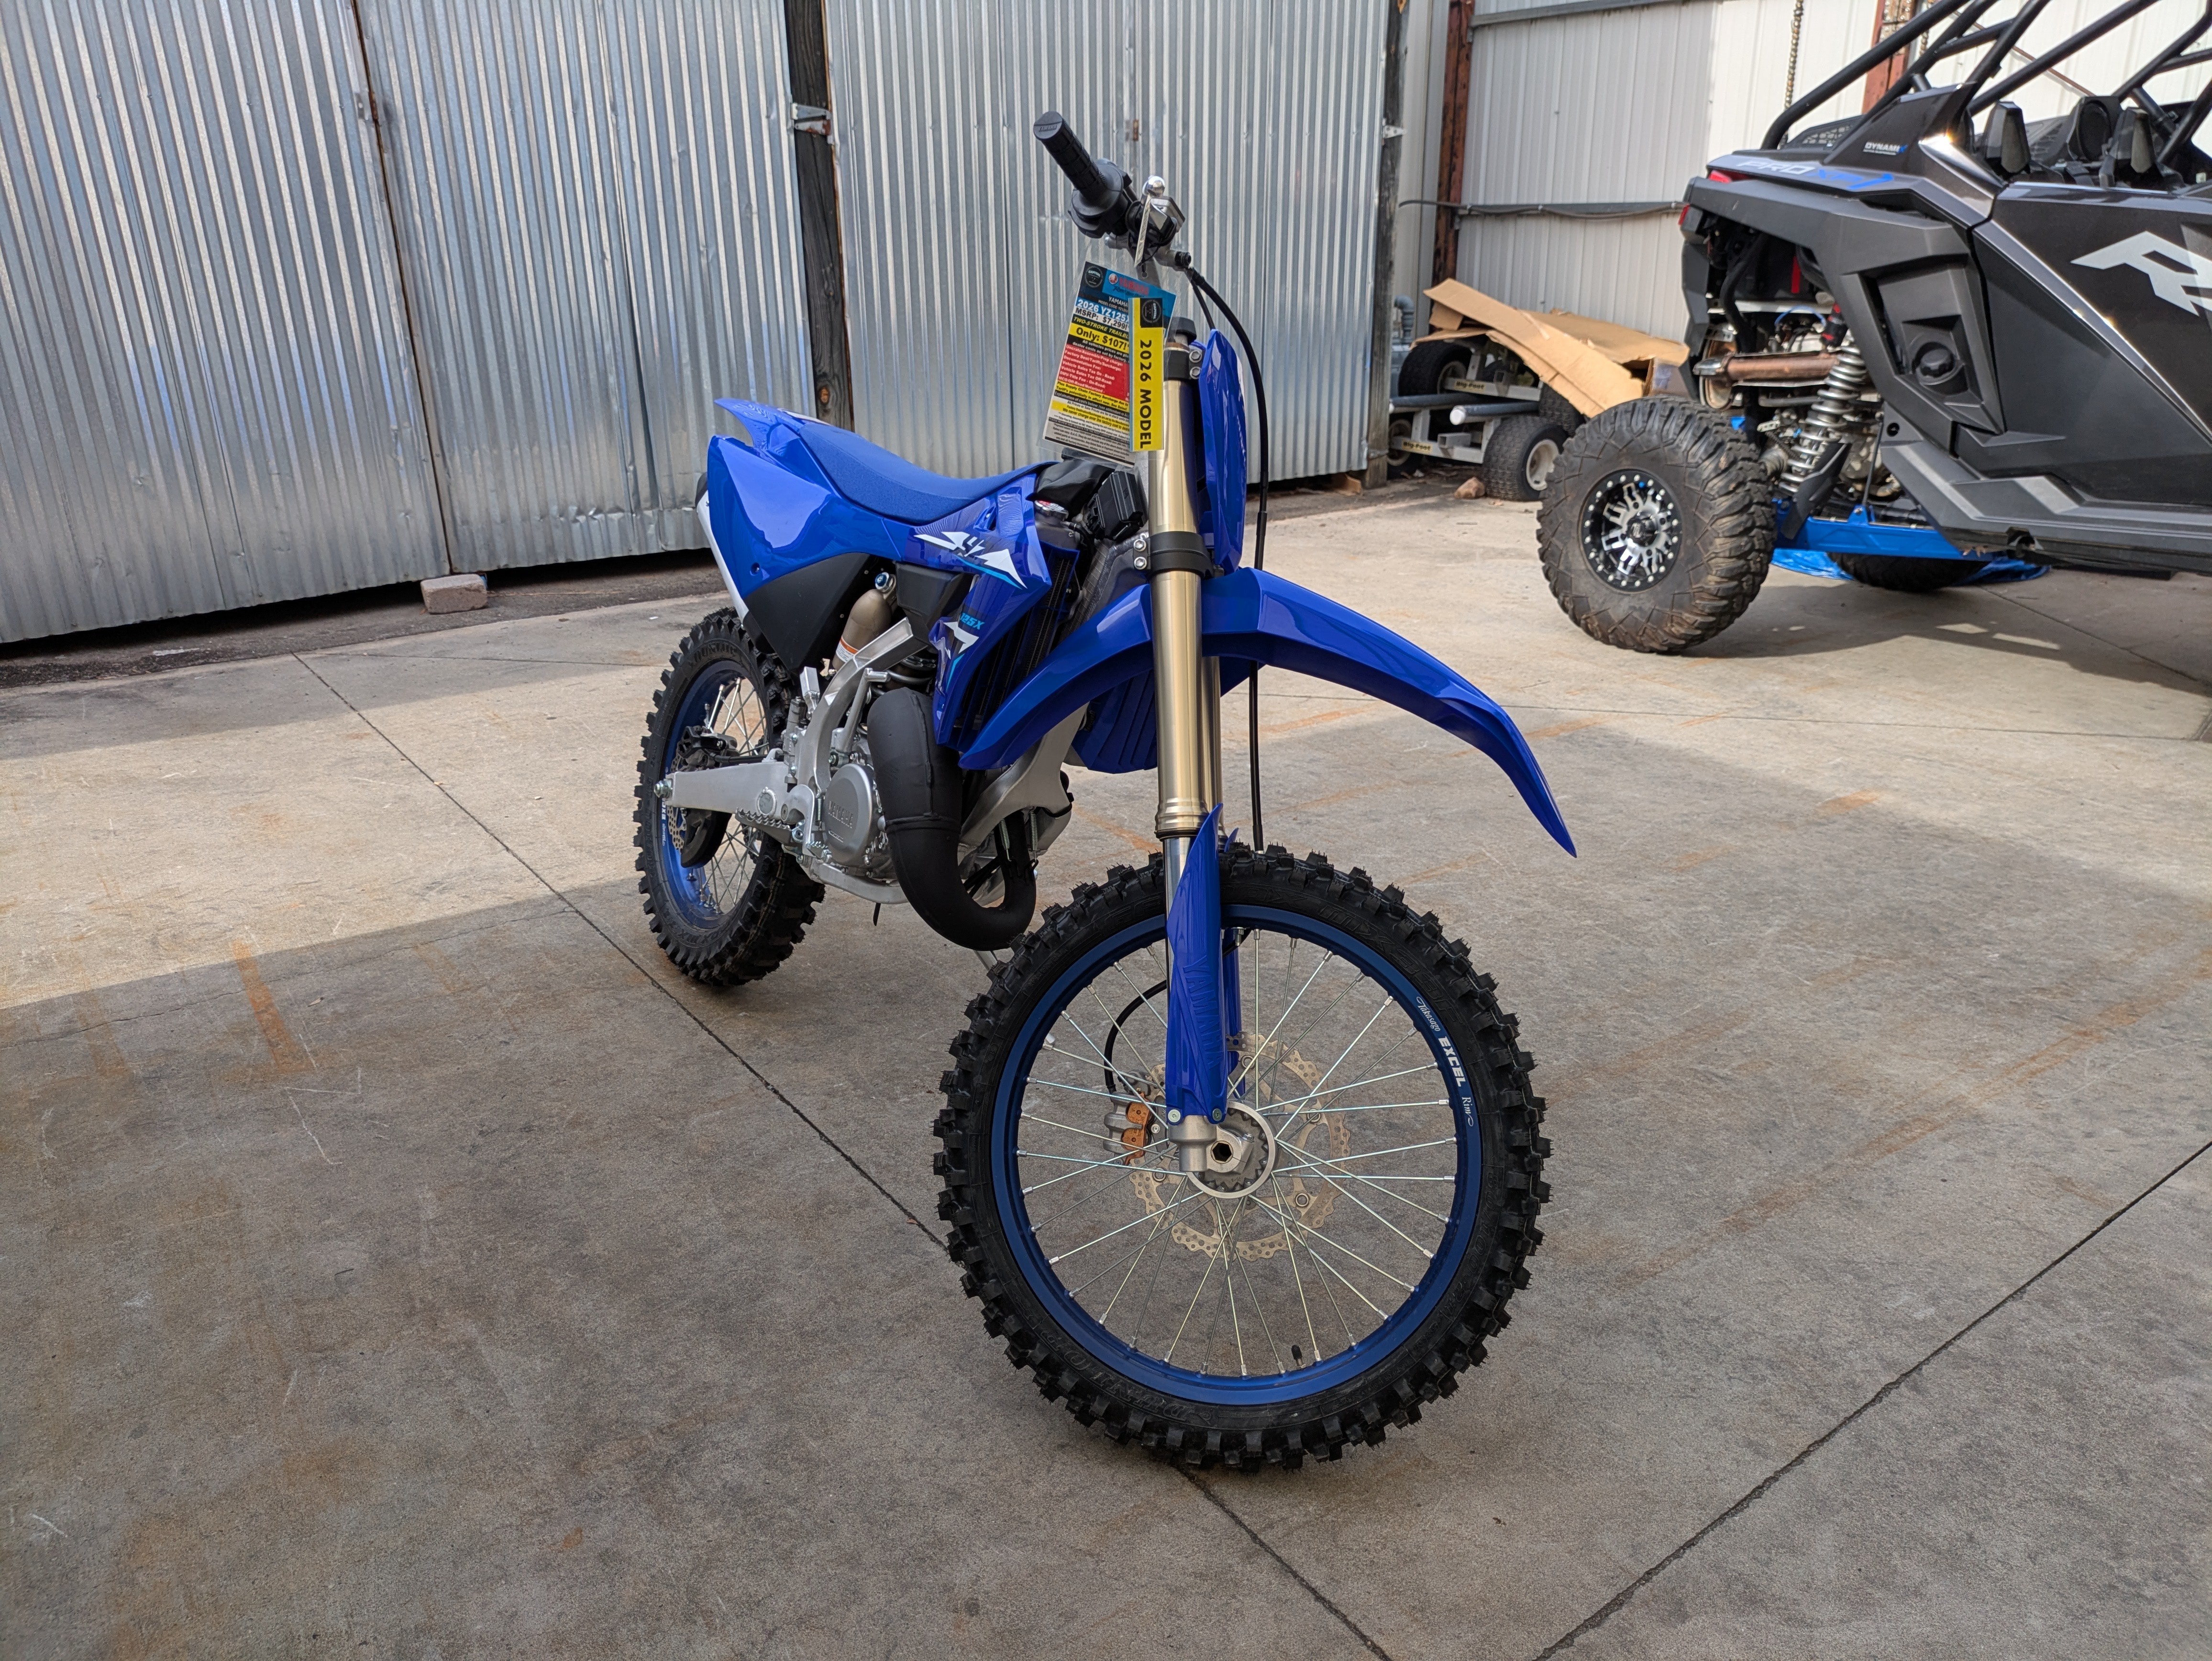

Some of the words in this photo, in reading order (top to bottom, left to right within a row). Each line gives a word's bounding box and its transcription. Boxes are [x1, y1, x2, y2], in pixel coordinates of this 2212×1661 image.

[1075, 307, 1099, 321] MSRP:
[1077, 298, 1099, 313] 2026
[1108, 296, 1128, 308] YAMAHA
[1073, 316, 1107, 332] TWO-STROKE
[1108, 328, 1130, 339] TRAILBL
[1075, 326, 1100, 343] Only:
[1101, 334, 1129, 352] $107!
[1140, 339, 1152, 382] 2026
[1140, 388, 1151, 449] MODEL
[960, 612, 985, 630] 125X
[1183, 955, 1225, 1070] YAMAHA
[1416, 997, 1441, 1032] Takasago
[1438, 1036, 1466, 1087] EXCEL
[1462, 1096, 1474, 1127] Rim
